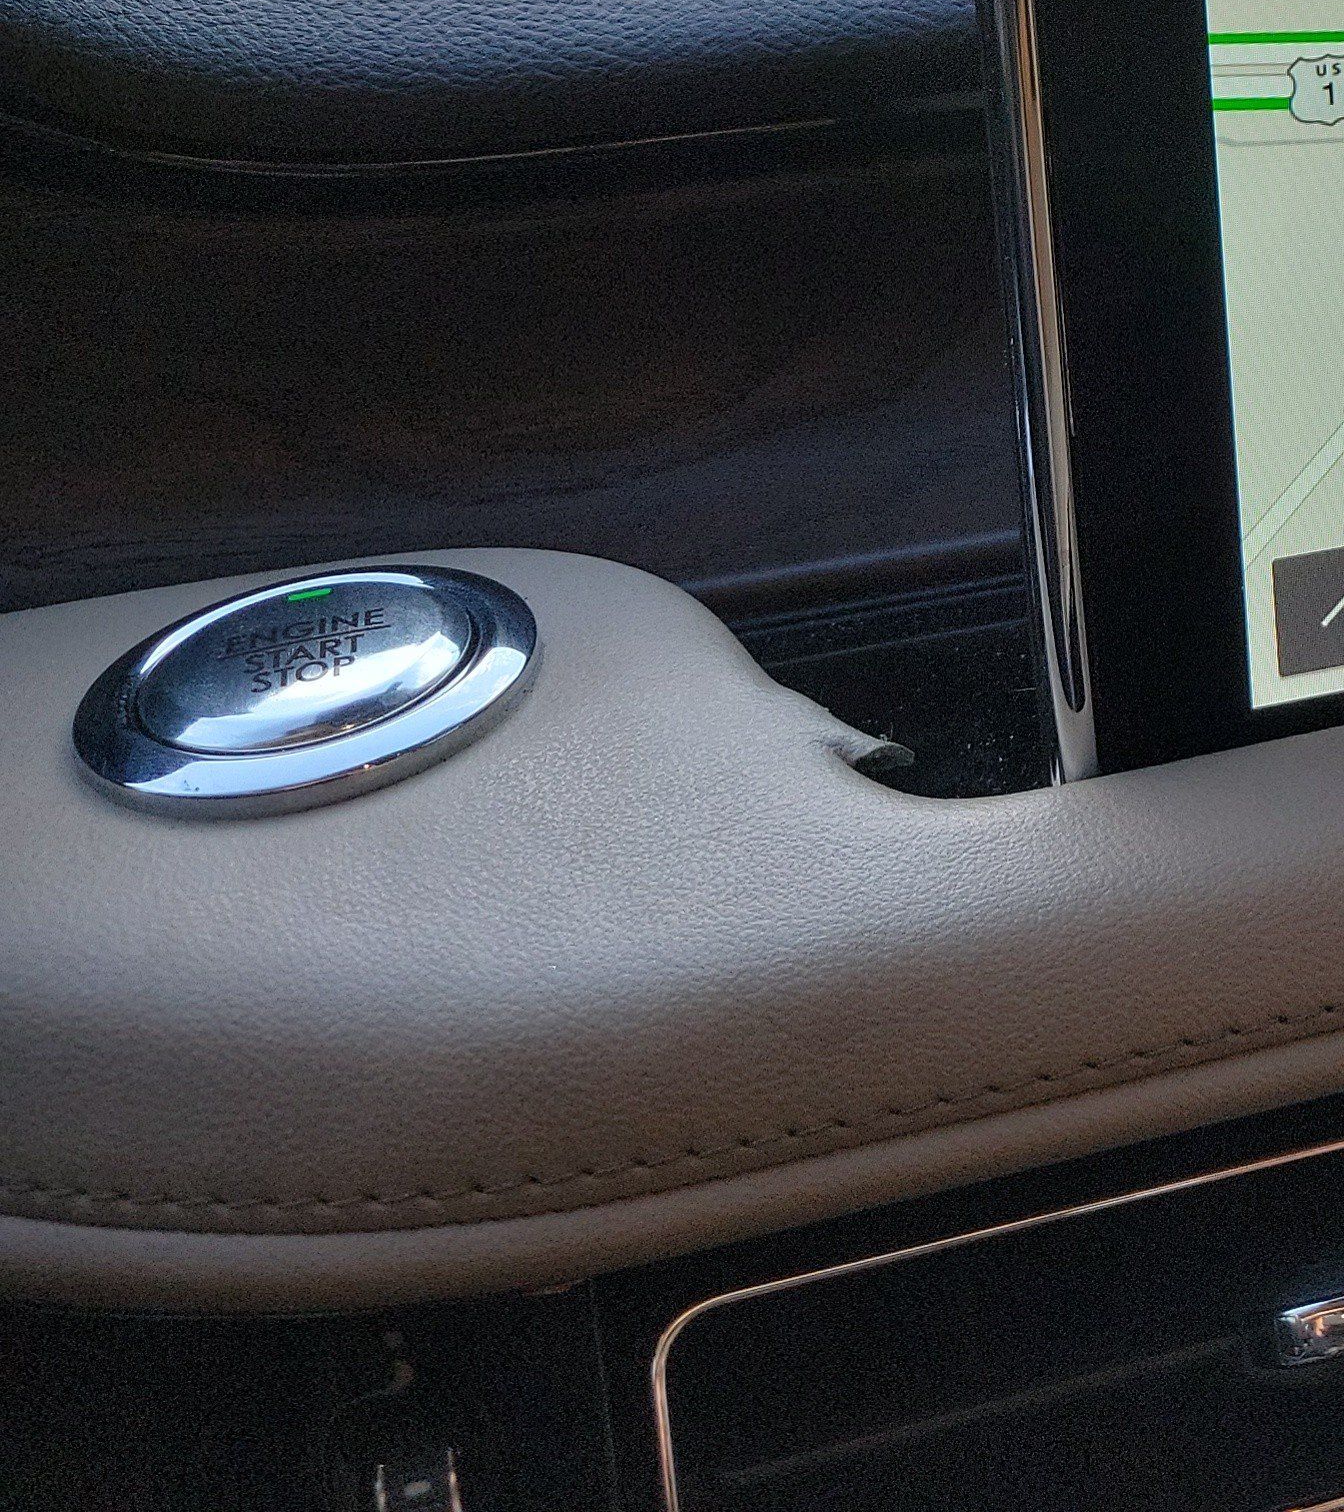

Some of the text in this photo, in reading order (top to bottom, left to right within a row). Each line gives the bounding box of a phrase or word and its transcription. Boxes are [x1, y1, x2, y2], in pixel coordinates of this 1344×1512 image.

[1315, 62, 1342, 77] US
[1322, 81, 1334, 105] 1
[226, 607, 385, 654] ENGINE
[244, 633, 365, 674] START
[250, 655, 356, 693] STOP
